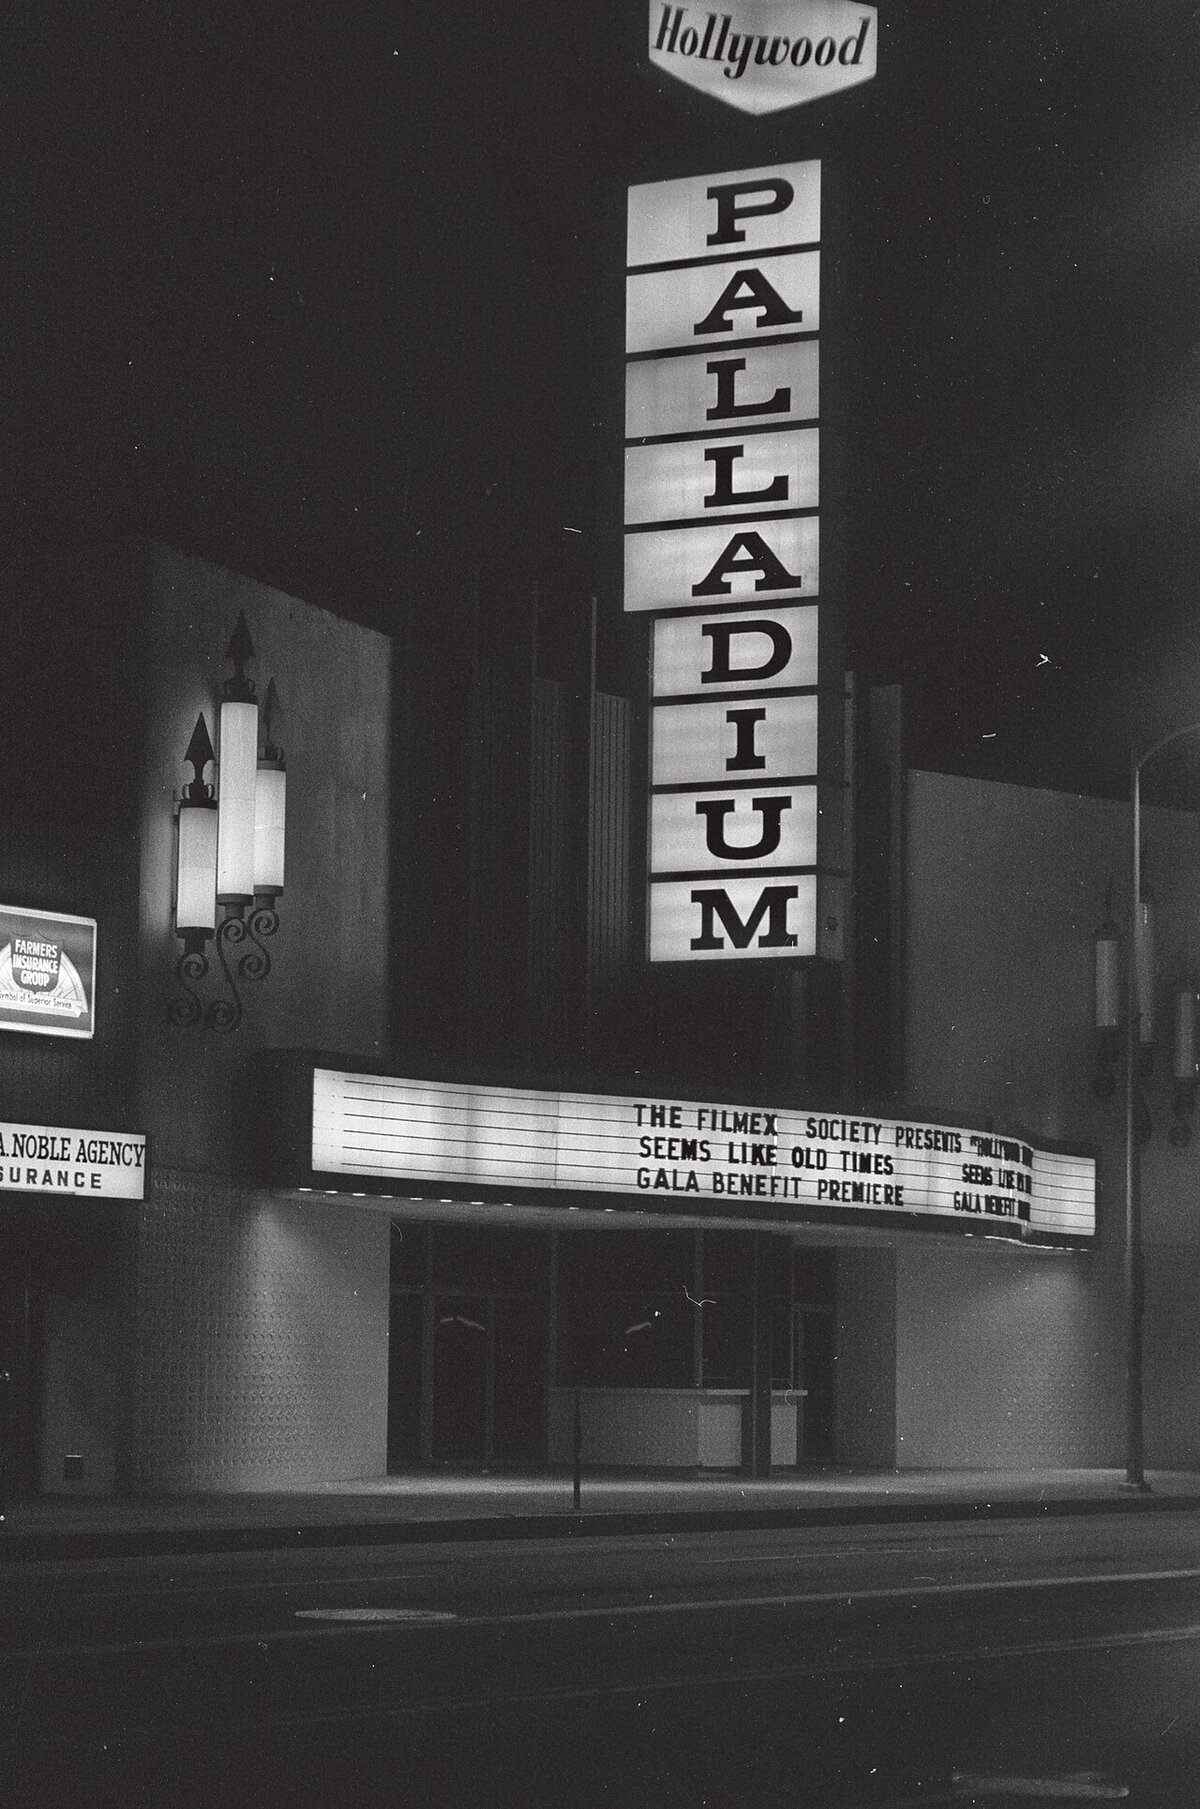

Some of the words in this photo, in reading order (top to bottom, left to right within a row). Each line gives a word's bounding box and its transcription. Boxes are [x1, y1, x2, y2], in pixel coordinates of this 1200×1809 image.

[652, 2, 871, 79] Hollywood
[691, 177, 803, 951] PALLADIUM
[15, 939, 58, 958] FARMERS
[13, 953, 59, 974] INSURANCE
[20, 970, 50, 987] GROUP
[0, 991, 18, 1001] ymbol
[28, 994, 51, 1006] Superior
[53, 998, 72, 1009] Service
[634, 1104, 682, 1128] THE
[697, 1109, 778, 1136] FILMEX
[805, 1117, 882, 1145] SOCIETY
[895, 1126, 962, 1153] PRESENTS
[75, 1139, 146, 1167] AGENCY
[639, 1136, 711, 1162] SEEMS
[728, 1141, 778, 1166] LIKE
[791, 1146, 828, 1170] OLD
[840, 1150, 894, 1175] TIMES
[636, 1167, 700, 1192] GALA
[712, 1172, 802, 1198] BENEFIT
[817, 1179, 904, 1206] PREMIERE
[953, 1191, 982, 1214] GALA
